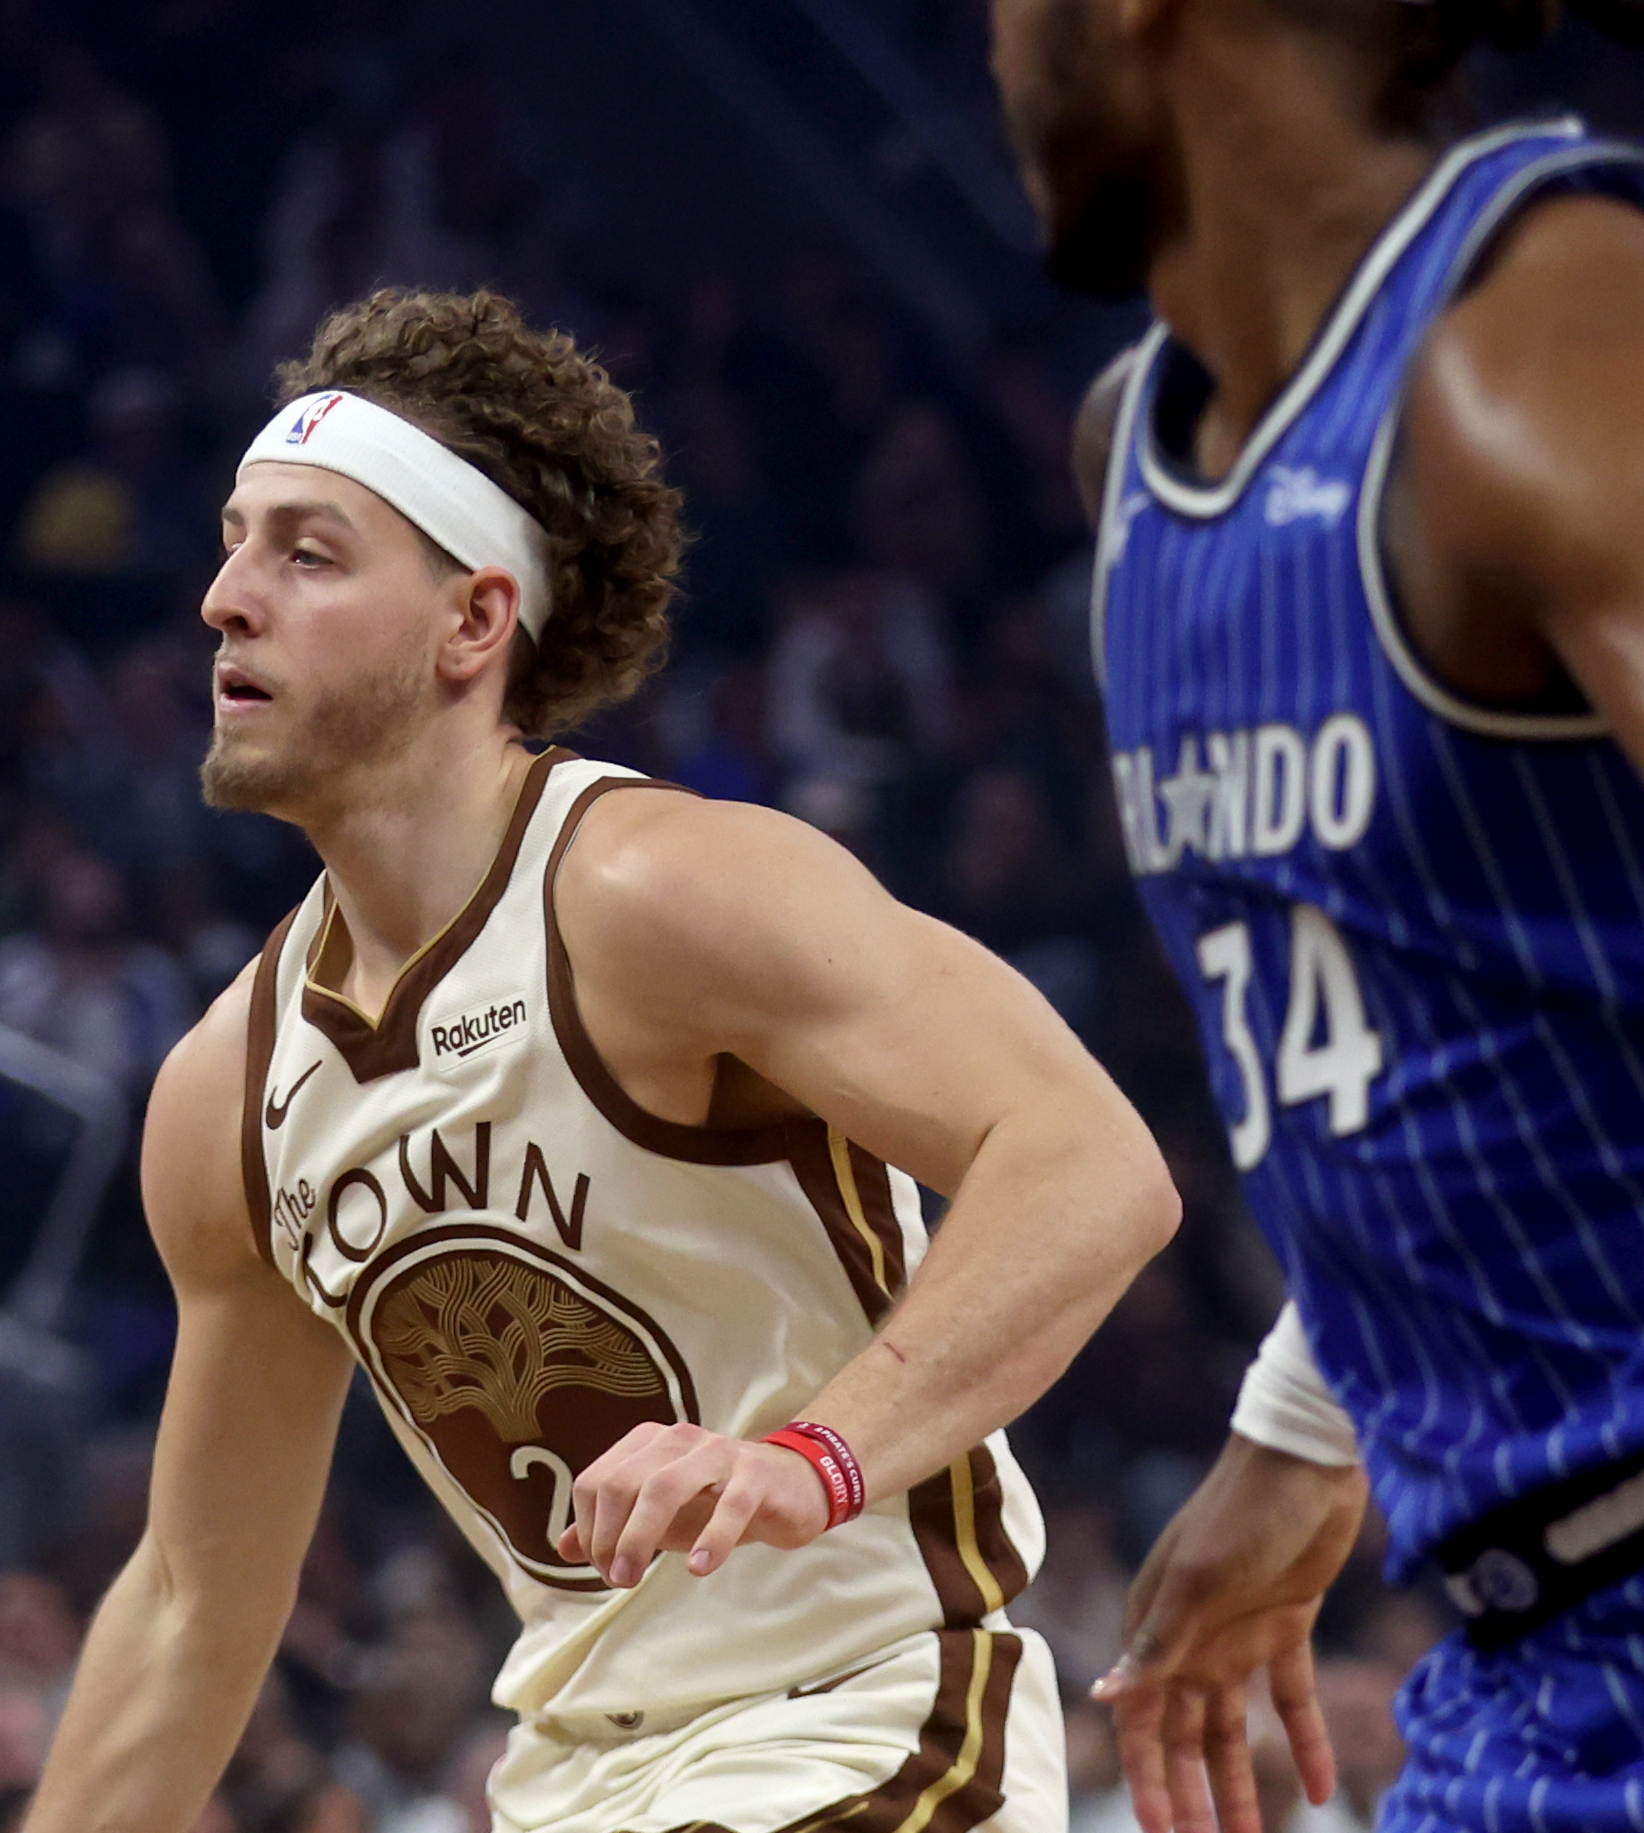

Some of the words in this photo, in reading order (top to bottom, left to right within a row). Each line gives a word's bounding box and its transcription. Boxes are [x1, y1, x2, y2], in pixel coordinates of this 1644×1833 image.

[431, 1000, 526, 1056] Rakuten
[1197, 902, 1383, 1172] 34
[275, 1178, 315, 1251] The
[819, 1455, 848, 1504] GLORY
